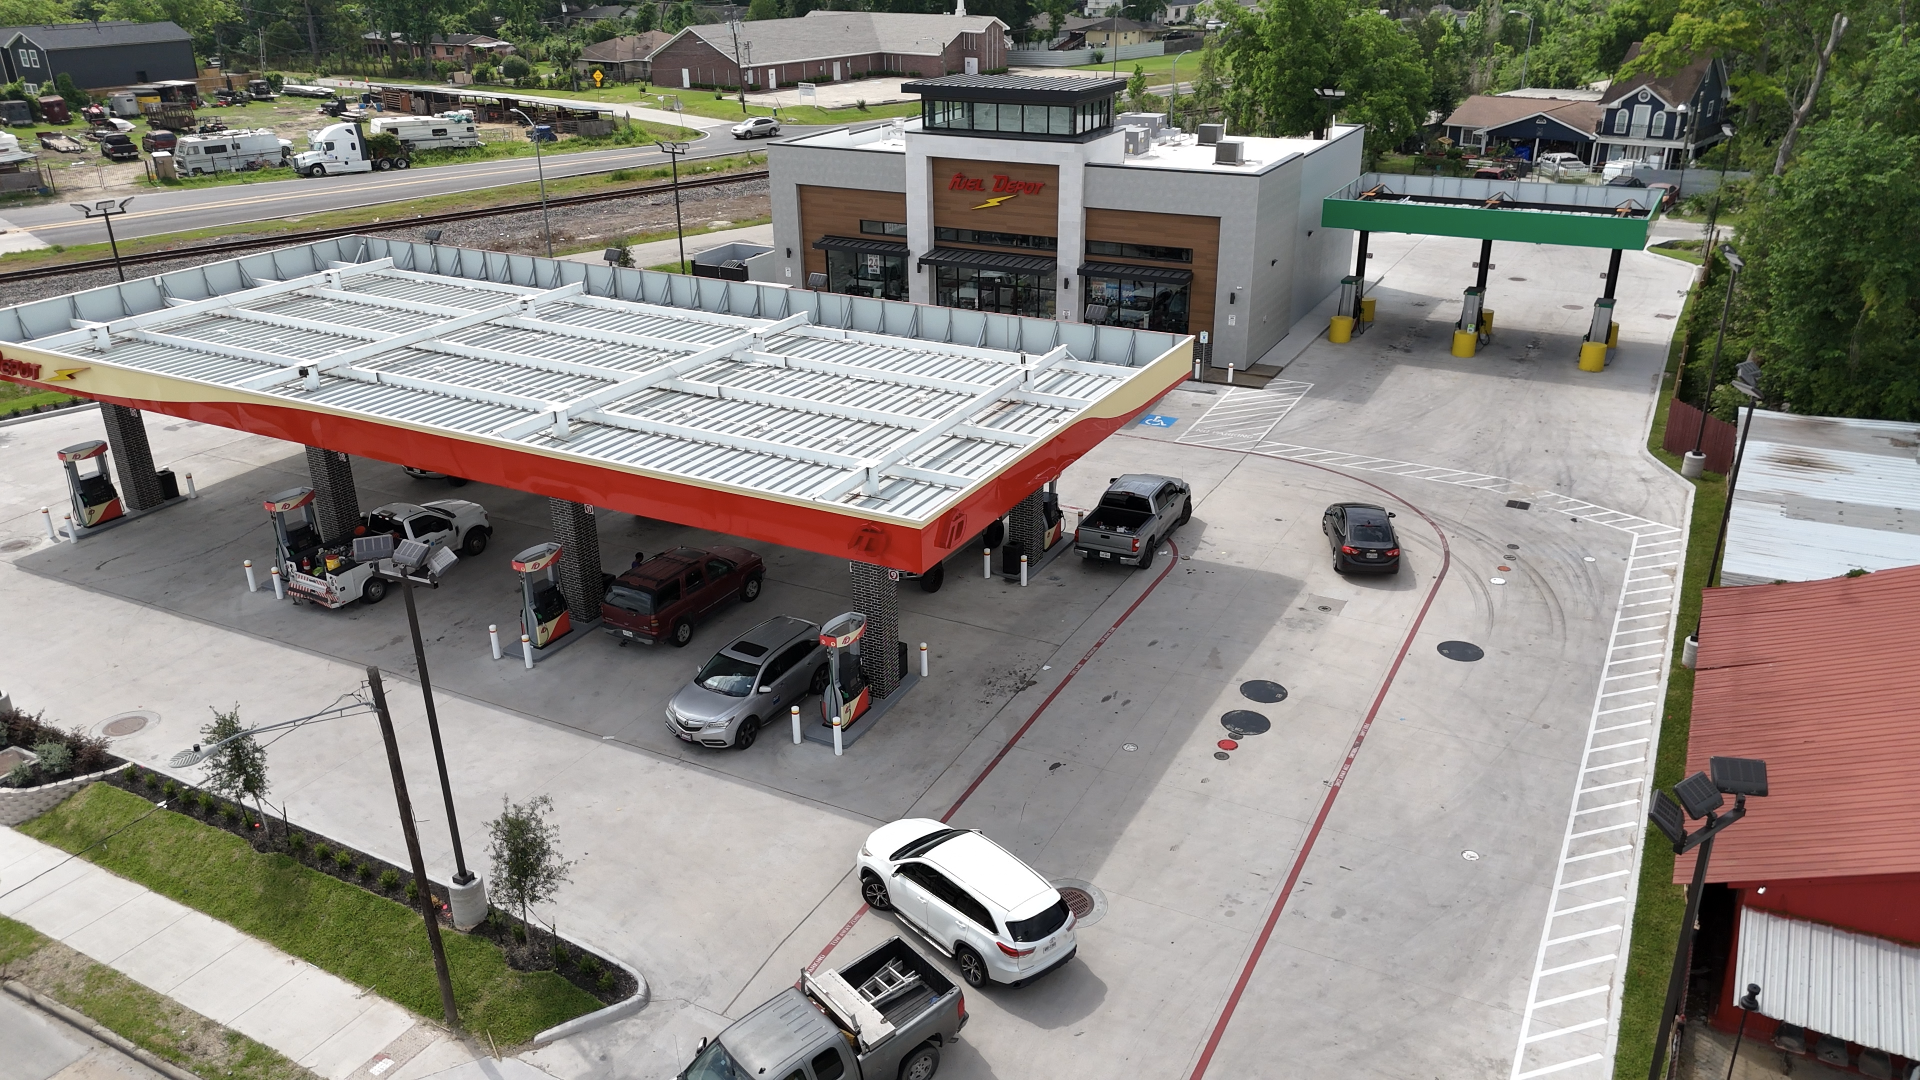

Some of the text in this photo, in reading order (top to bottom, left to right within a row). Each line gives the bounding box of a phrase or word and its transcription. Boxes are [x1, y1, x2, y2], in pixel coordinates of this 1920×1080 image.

[948, 172, 1045, 195] FUEL DEPOT
[868, 258, 879, 268] 24
[0, 350, 42, 380] EPOT
[1213, 430, 1254, 439] PARKING
